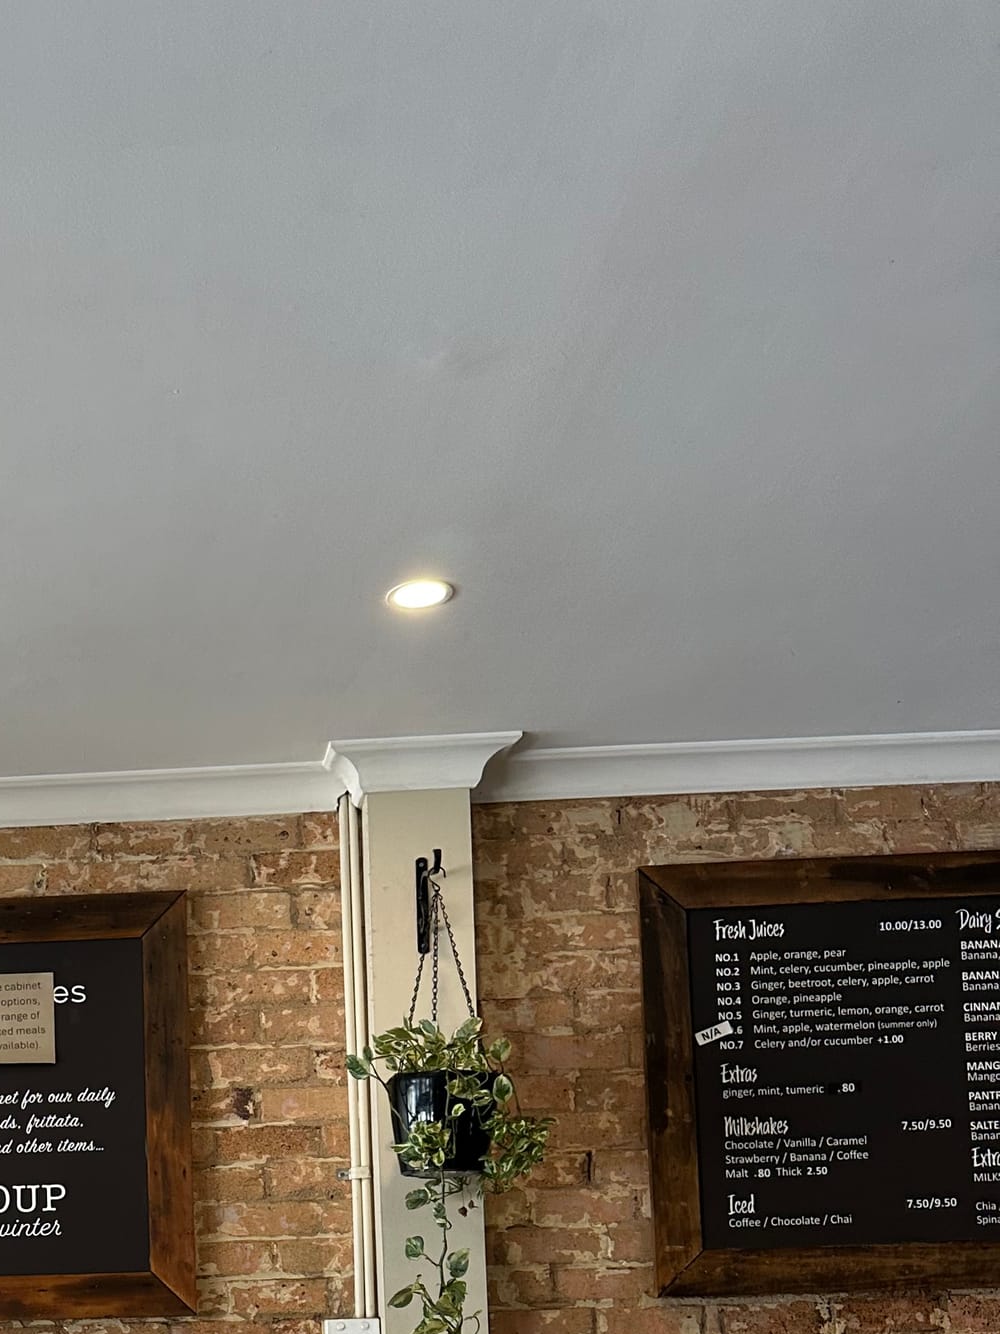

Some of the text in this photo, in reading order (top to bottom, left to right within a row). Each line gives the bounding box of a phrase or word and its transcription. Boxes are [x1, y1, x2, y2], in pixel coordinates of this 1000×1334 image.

[955, 909, 992, 933] Dairy
[713, 919, 941, 941] Fresh Juices 10.00/13.00
[715, 949, 846, 962] NO.1 Apple, orange, pear
[716, 959, 950, 977] NO.2 Mint, celery, cucumber, pineapple, apple
[4, 982, 41, 991] cabinet
[717, 992, 842, 1006] NO.4 Orange, pineapple
[702, 1028, 722, 1041] N/A
[720, 1063, 757, 1084] Extras
[21, 1090, 43, 1110] for
[48, 1092, 72, 1102] our
[77, 1087, 115, 1107] daily
[724, 1116, 951, 1138] Milkshakes 7.50/9.50
[16, 1138, 53, 1153] other
[725, 1136, 867, 1150] Chocolate Vanilla Caramel
[728, 1194, 957, 1215] Iced 7.50/9.50
[729, 1214, 852, 1228] Coffee Chocolate Chai
